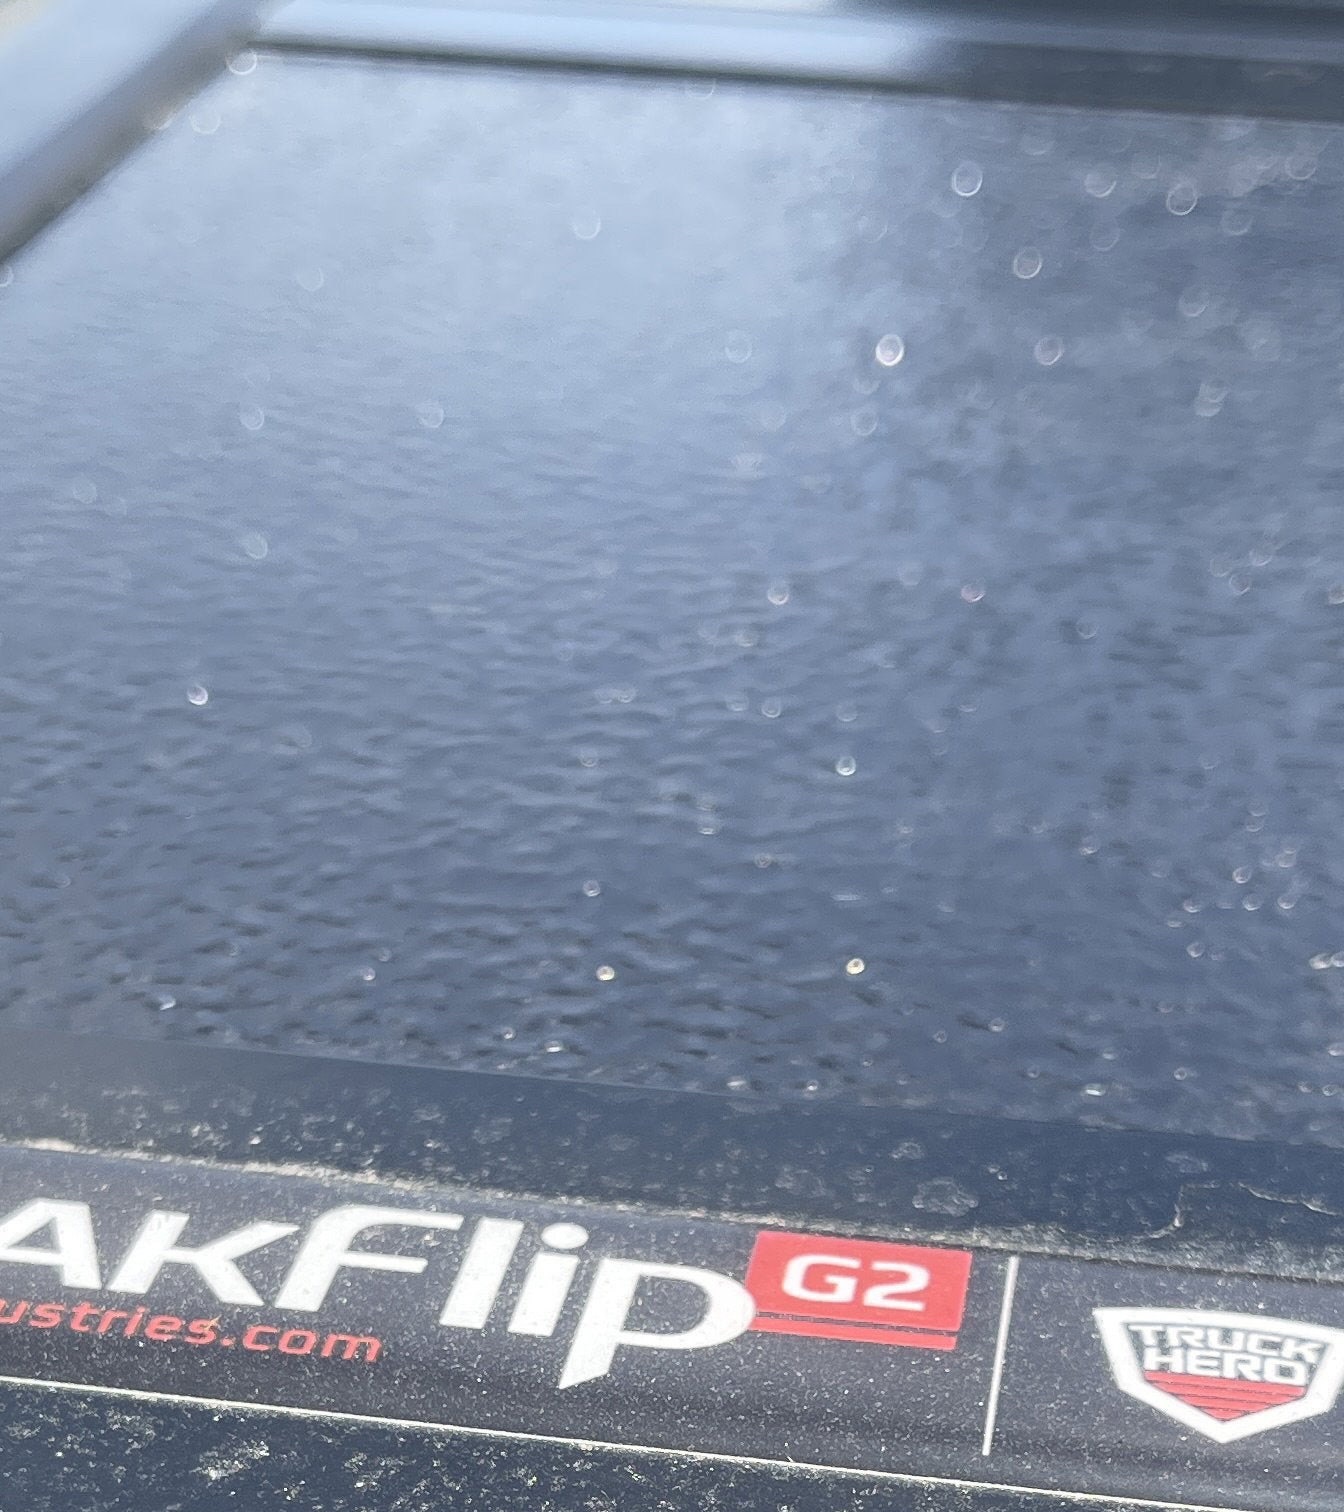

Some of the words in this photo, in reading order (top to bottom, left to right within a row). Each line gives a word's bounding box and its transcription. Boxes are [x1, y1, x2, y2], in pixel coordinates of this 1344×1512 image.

[782, 1255, 932, 1312] G2
[1128, 1323, 1325, 1364] TRUCK
[1143, 1348, 1307, 1384] HERO
